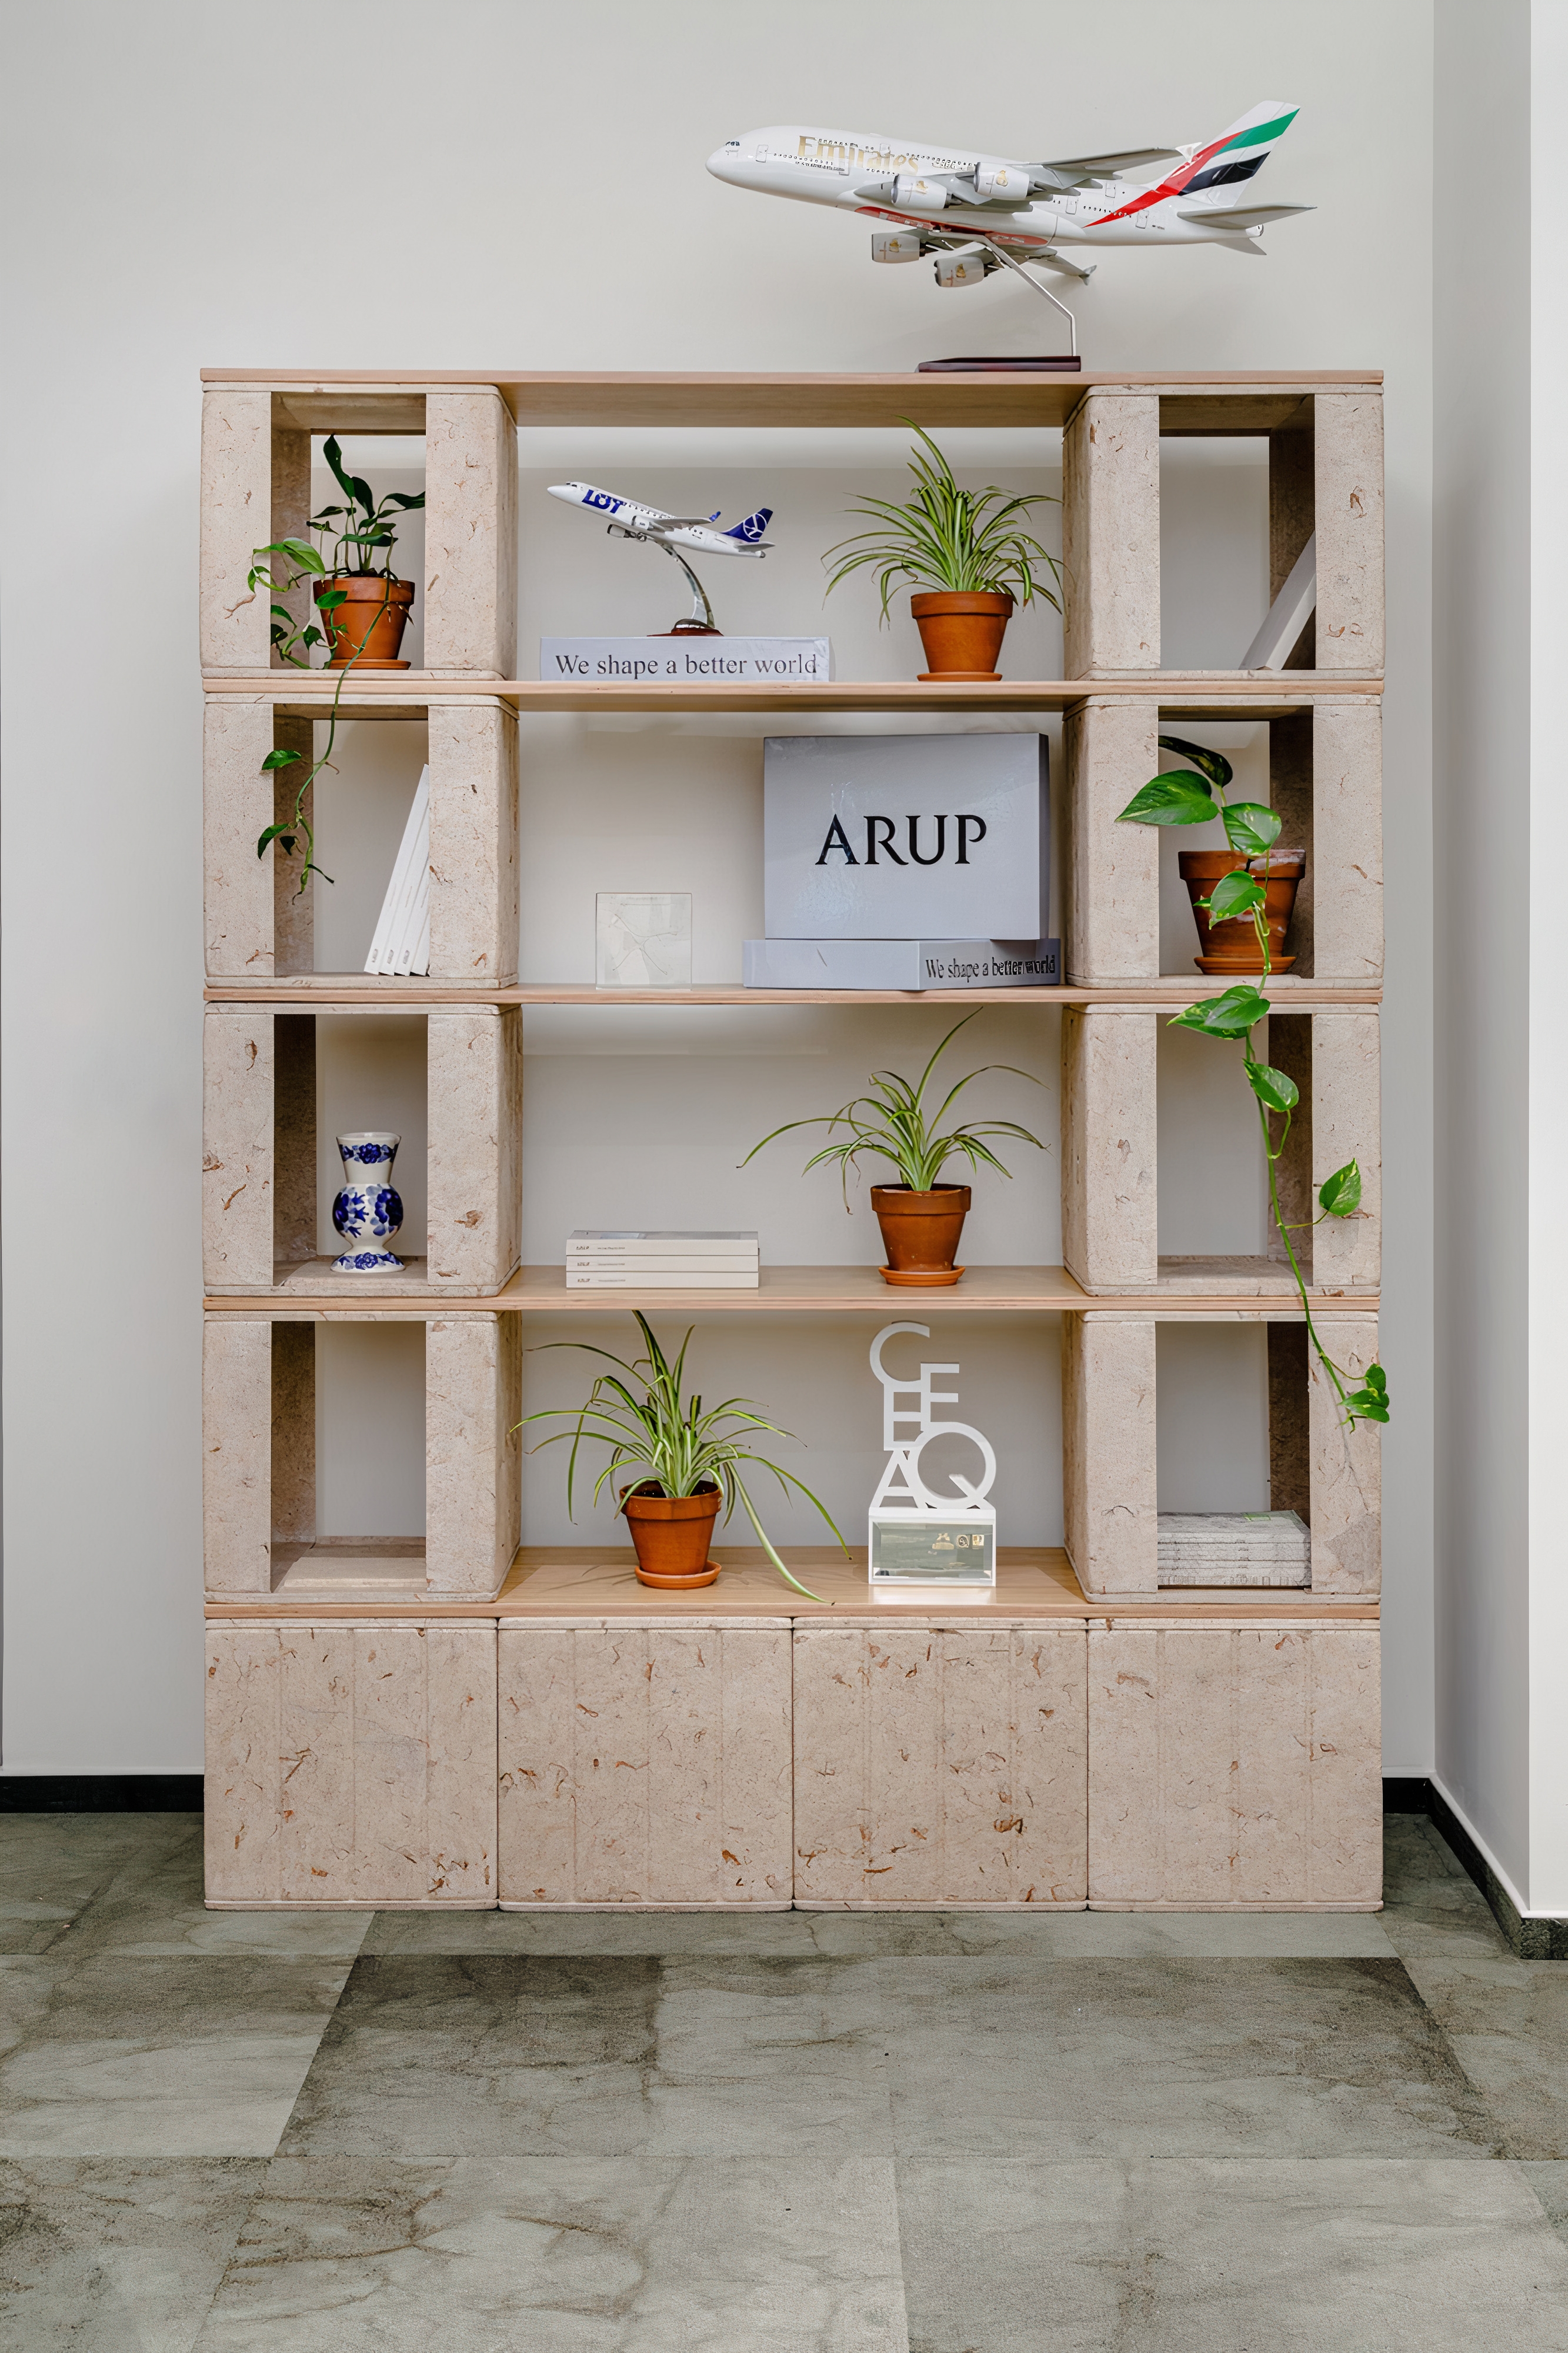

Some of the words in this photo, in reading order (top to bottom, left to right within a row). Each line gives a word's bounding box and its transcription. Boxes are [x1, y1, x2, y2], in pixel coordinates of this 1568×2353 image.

[798, 135, 919, 175] Emirates
[581, 489, 627, 514] LOT
[555, 655, 589, 675] We
[597, 654, 659, 680] shape
[666, 660, 678, 675] a
[685, 654, 748, 675] better
[754, 654, 817, 674] world
[815, 813, 987, 866] ARUP
[925, 959, 945, 979] We
[948, 958, 979, 983] shape
[982, 962, 989, 976] a
